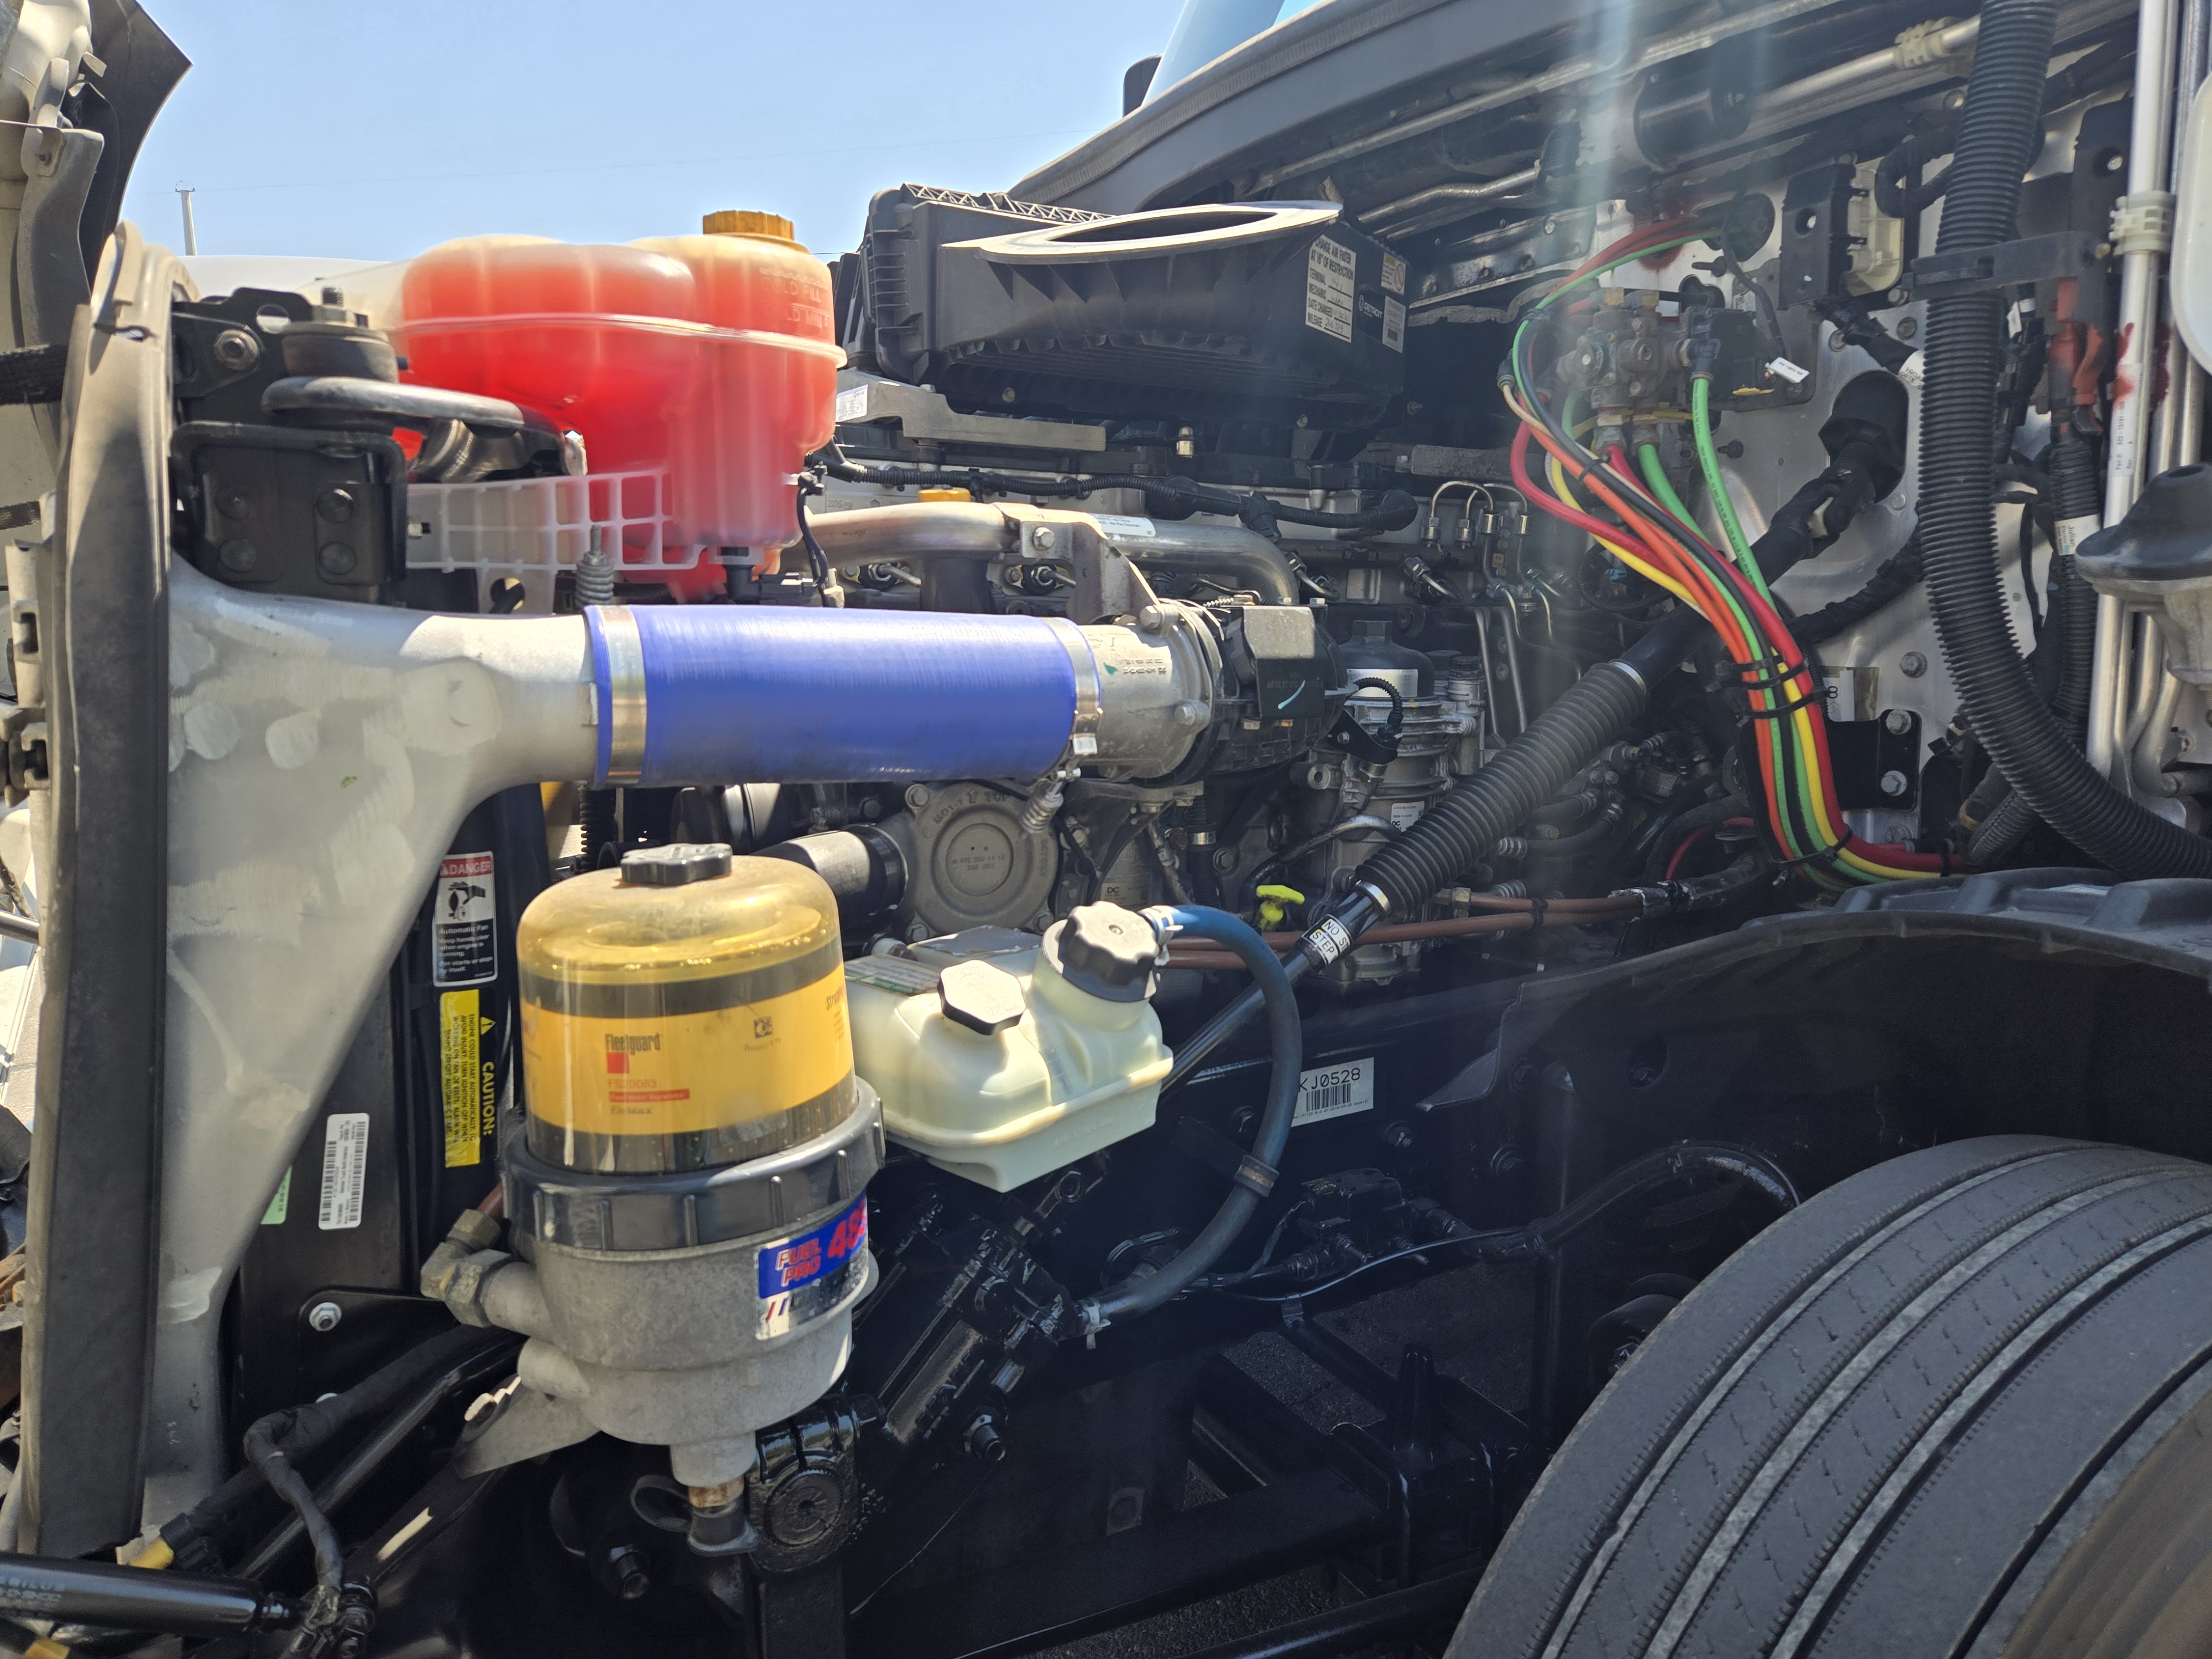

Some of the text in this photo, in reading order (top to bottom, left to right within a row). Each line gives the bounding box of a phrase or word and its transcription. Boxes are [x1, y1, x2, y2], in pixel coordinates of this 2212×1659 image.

[1329, 258, 1354, 282] RESTRICTION
[1308, 297, 1317, 311] DATE
[1317, 301, 1333, 317] CHANGED
[1364, 301, 1383, 320] DETROIT
[1307, 311, 1323, 328] MILEAGE
[440, 926, 477, 934] Automatic
[1324, 921, 1340, 936] NO
[1312, 931, 1335, 953] STEP
[605, 1032, 661, 1056] Fleetguard
[482, 1061, 495, 1136] CAUTION:
[775, 1237, 822, 1271] FUEL
[780, 1255, 822, 1288] PRO
